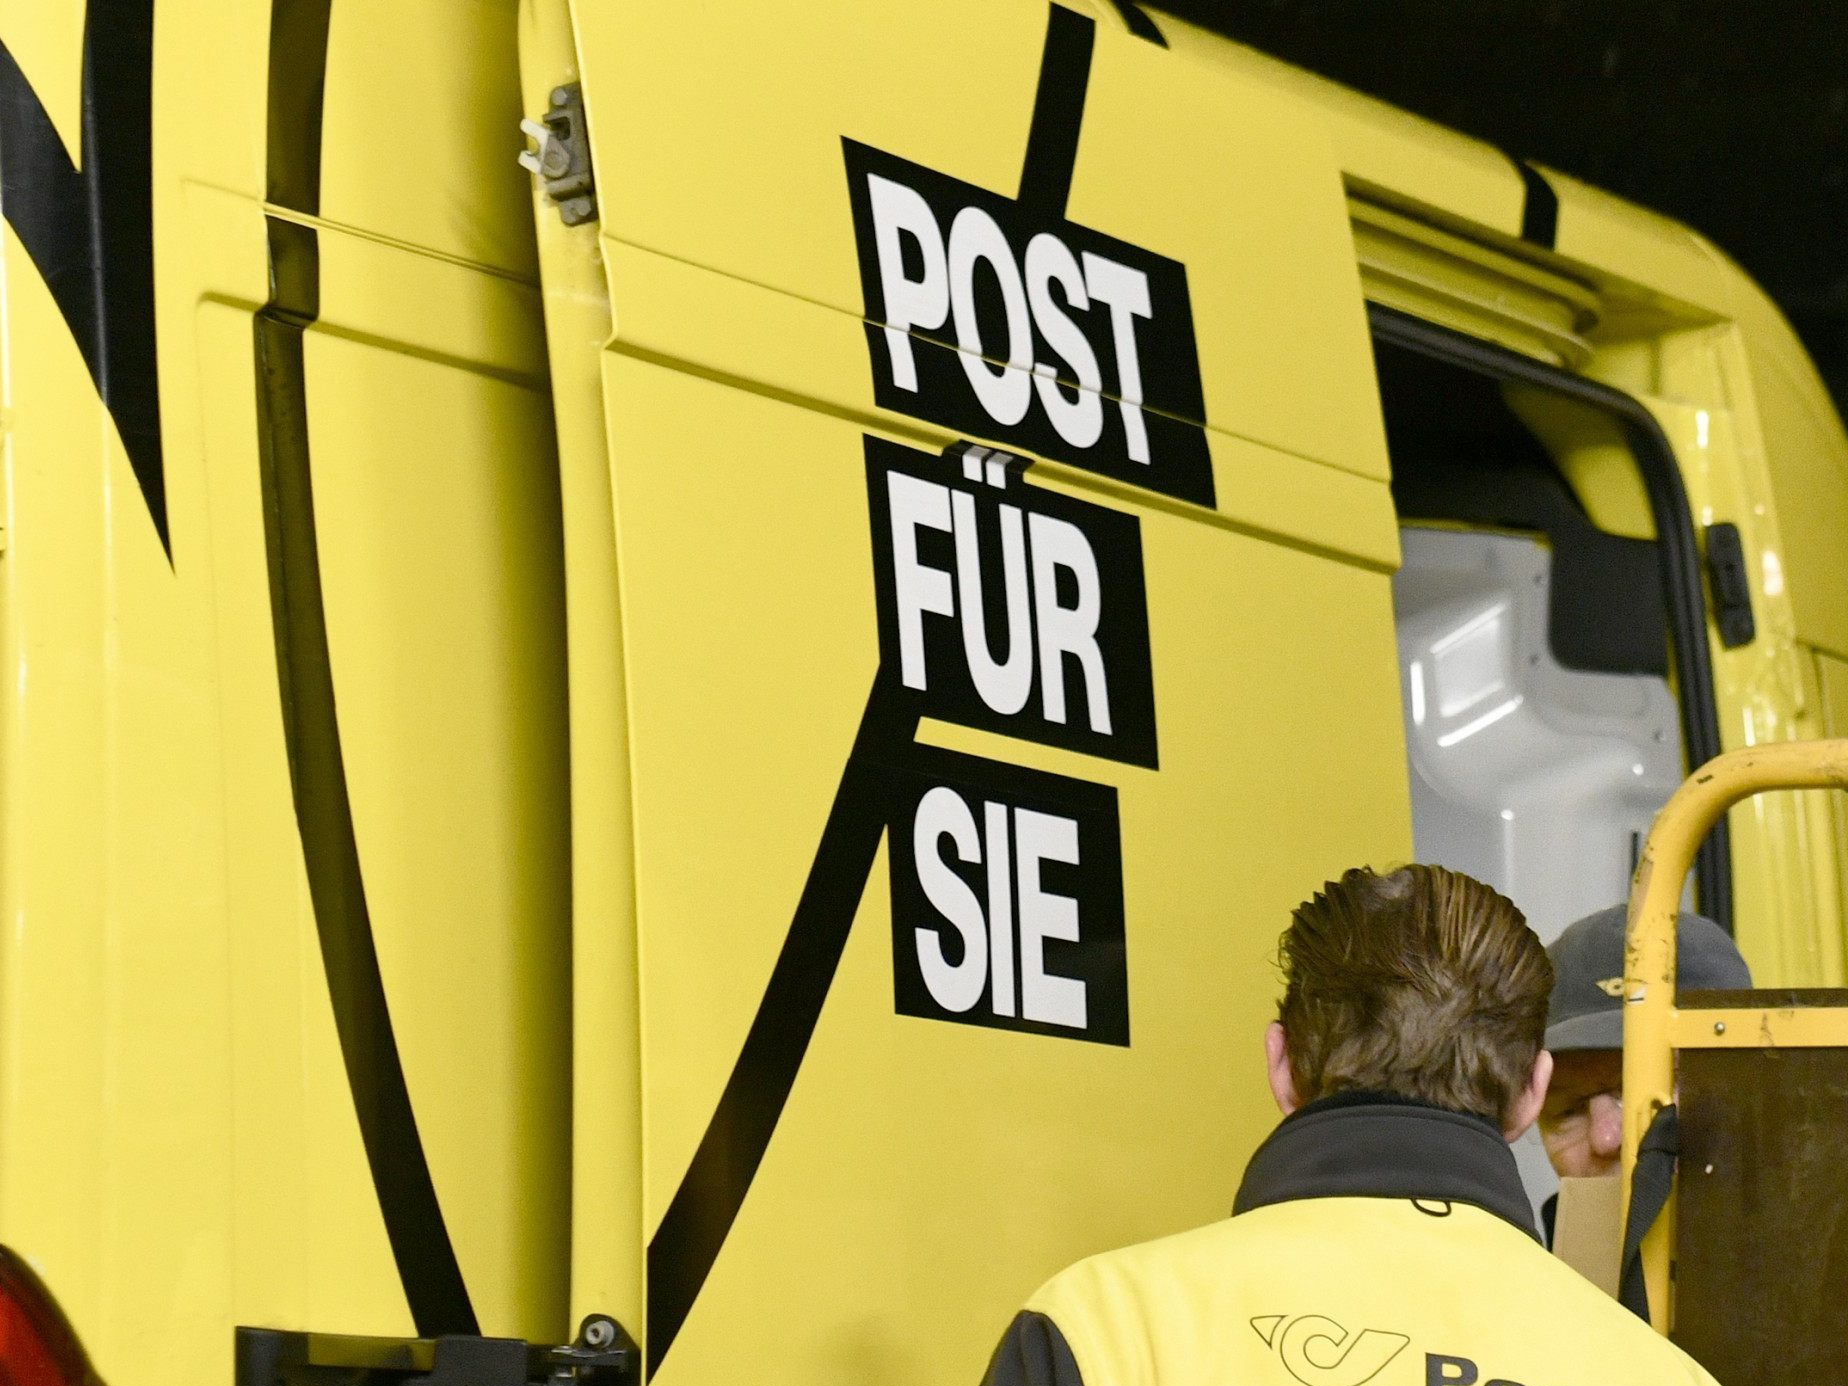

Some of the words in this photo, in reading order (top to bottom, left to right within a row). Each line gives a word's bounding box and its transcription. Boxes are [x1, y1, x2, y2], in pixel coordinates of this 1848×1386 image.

[867, 173, 1152, 465] POST
[886, 446, 1113, 736] FÜR
[913, 786, 1087, 1029] SIE
